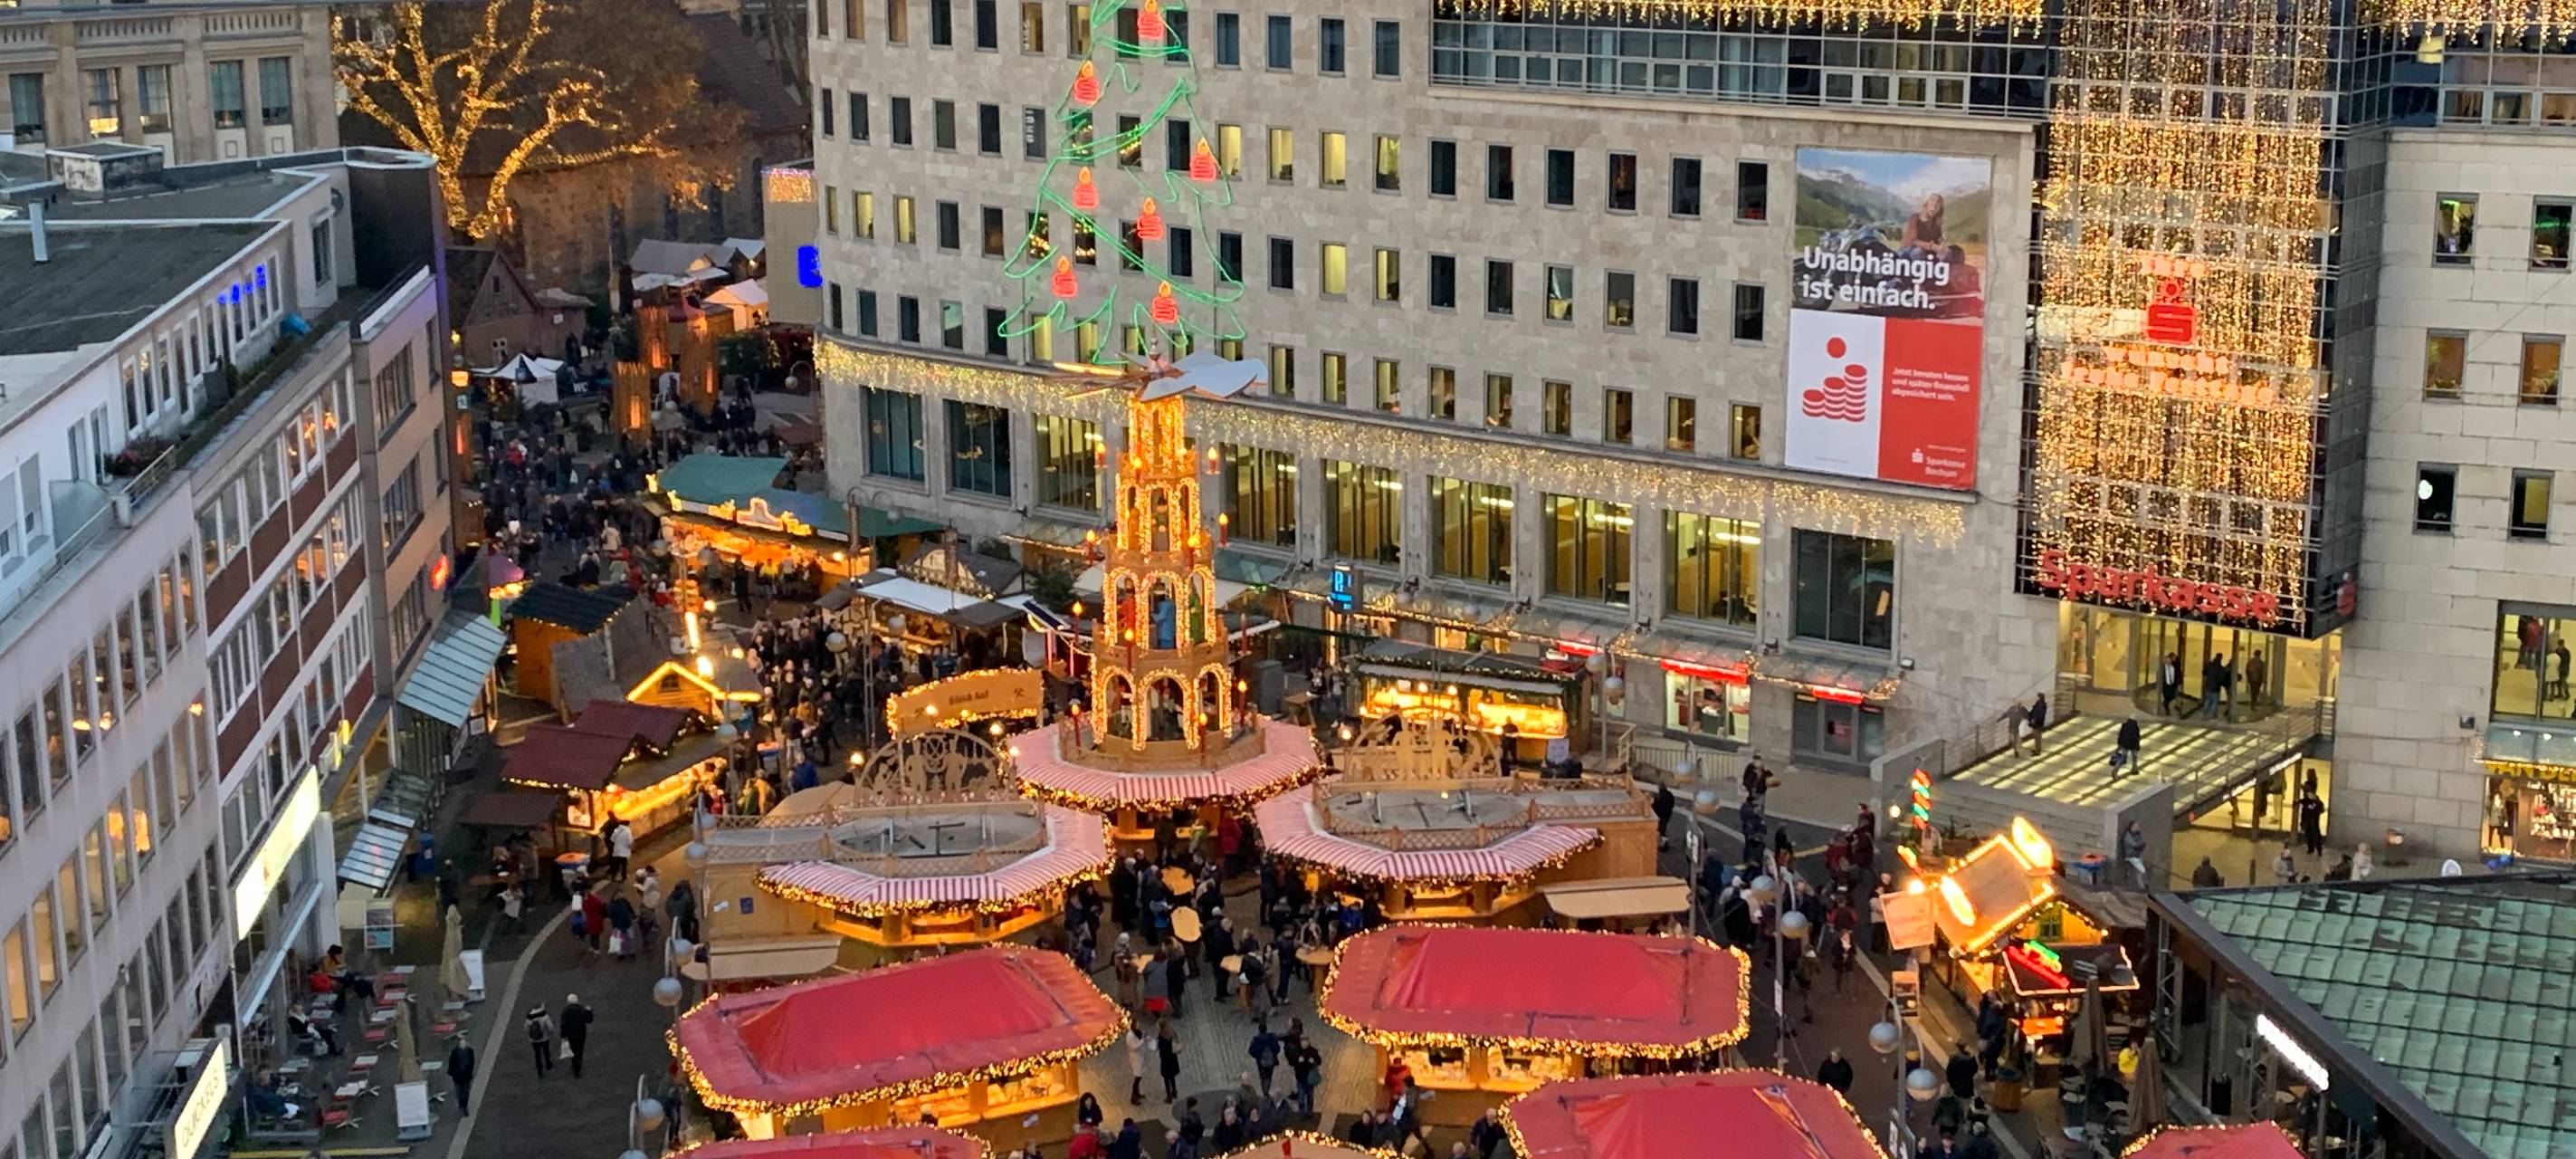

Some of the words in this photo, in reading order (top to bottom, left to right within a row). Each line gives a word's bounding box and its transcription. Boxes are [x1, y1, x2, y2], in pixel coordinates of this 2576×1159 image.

[1804, 245, 1950, 286] Unabhängig
[1801, 274, 1833, 300] ist
[1839, 279, 1935, 310] einfach.
[574, 381, 588, 393] WC
[1925, 455, 1966, 470] Sparkasse
[1925, 466, 1957, 477] Bochum
[2038, 549, 2277, 621] Sparkasse
